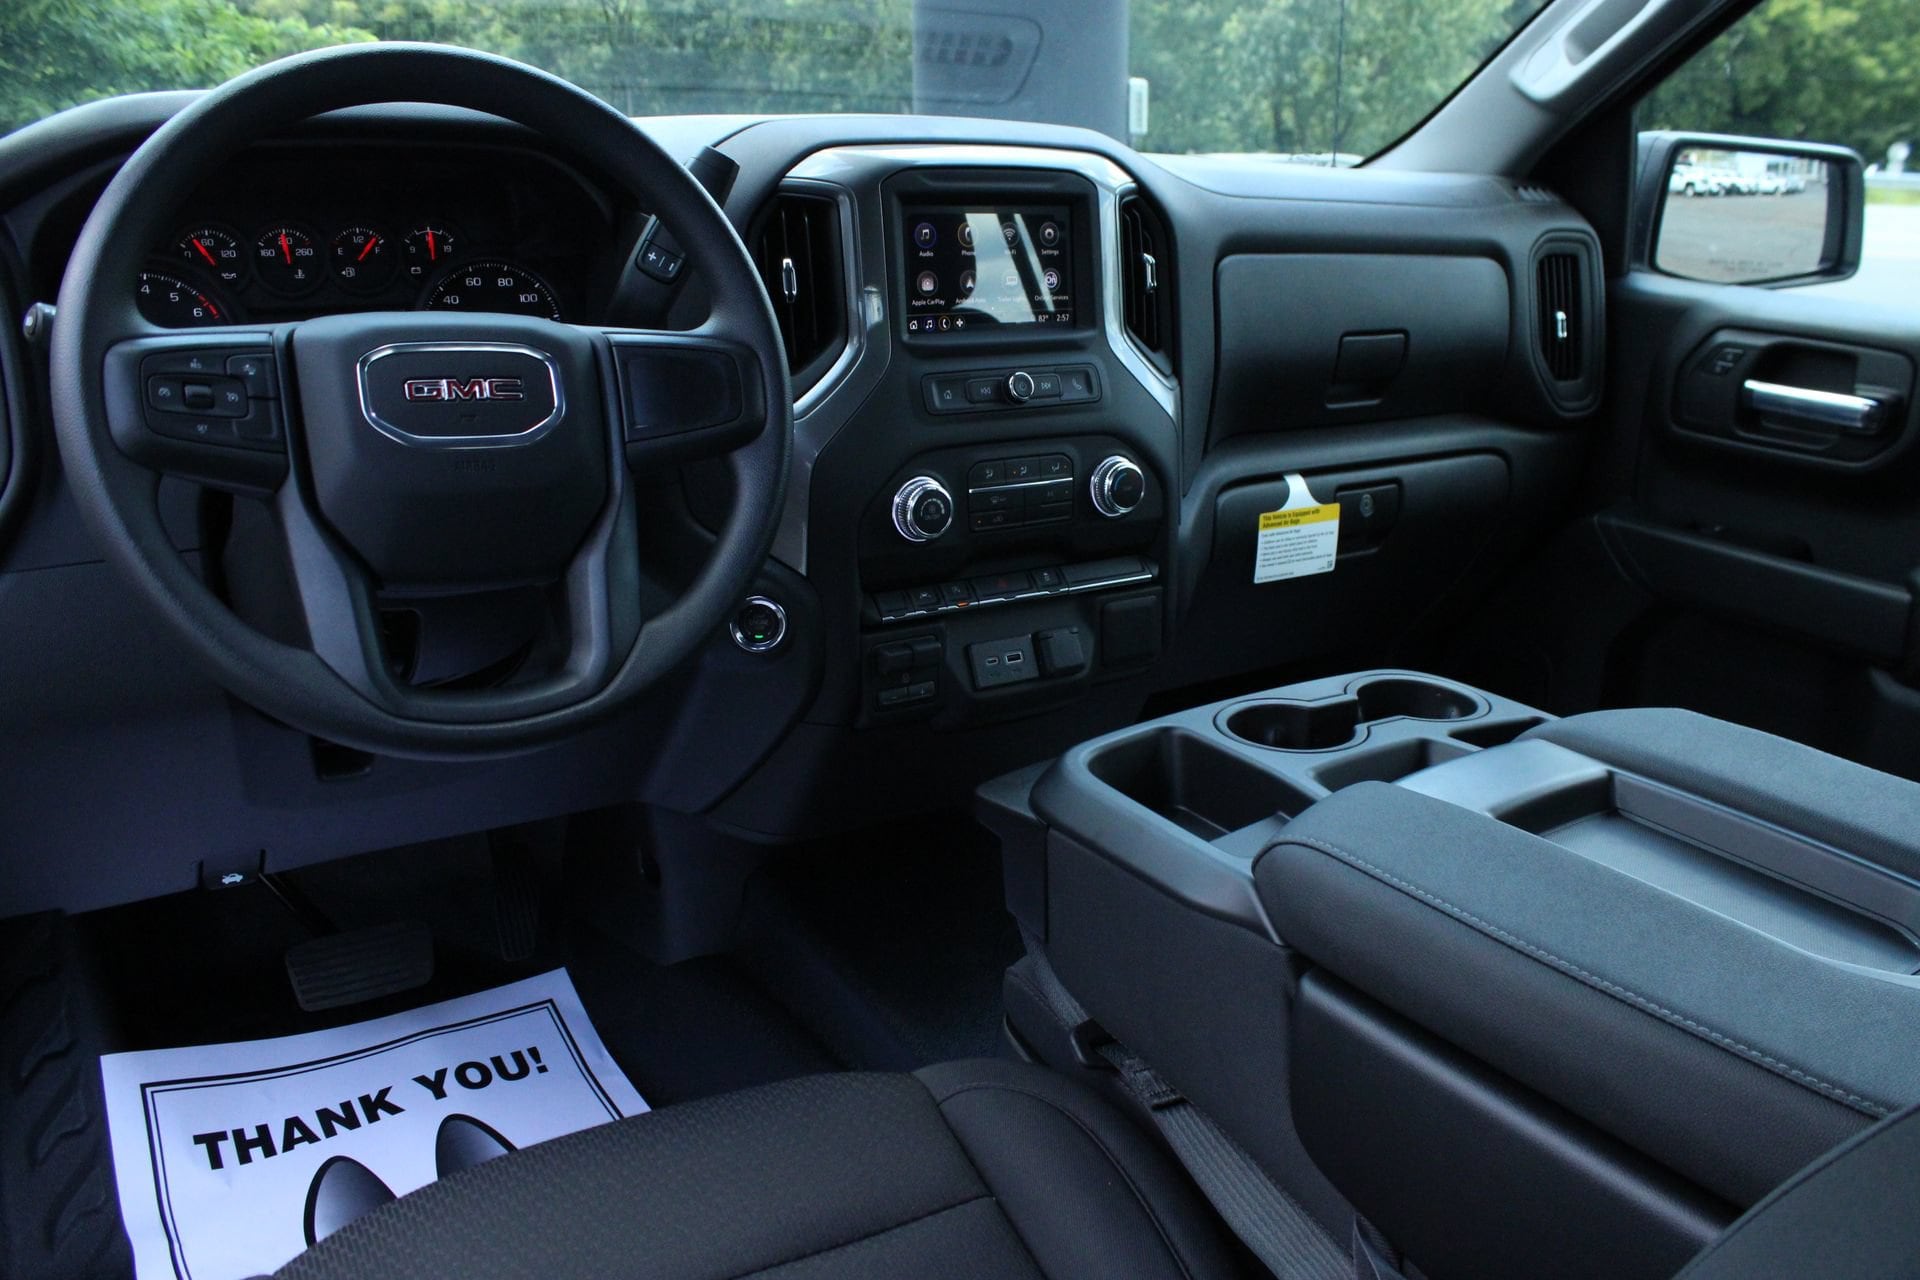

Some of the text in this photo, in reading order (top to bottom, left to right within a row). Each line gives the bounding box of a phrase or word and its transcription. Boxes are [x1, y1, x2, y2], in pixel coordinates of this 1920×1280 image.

[220, 250, 236, 258] 120
[260, 249, 275, 257] 160
[295, 248, 313, 256] 260
[337, 248, 344, 256] E
[375, 246, 381, 255] F
[465, 277, 482, 287] 60
[497, 277, 513, 287] 80
[140, 284, 150, 294] 4
[169, 292, 179, 302] 5
[443, 295, 459, 305] 40
[519, 293, 538, 303] 100
[911, 299, 926, 307] Apple
[193, 307, 203, 318] 6
[1056, 314, 1070, 322] 2:57
[404, 378, 523, 401] GMC
[193, 1046, 550, 1170] THANK YOU!
